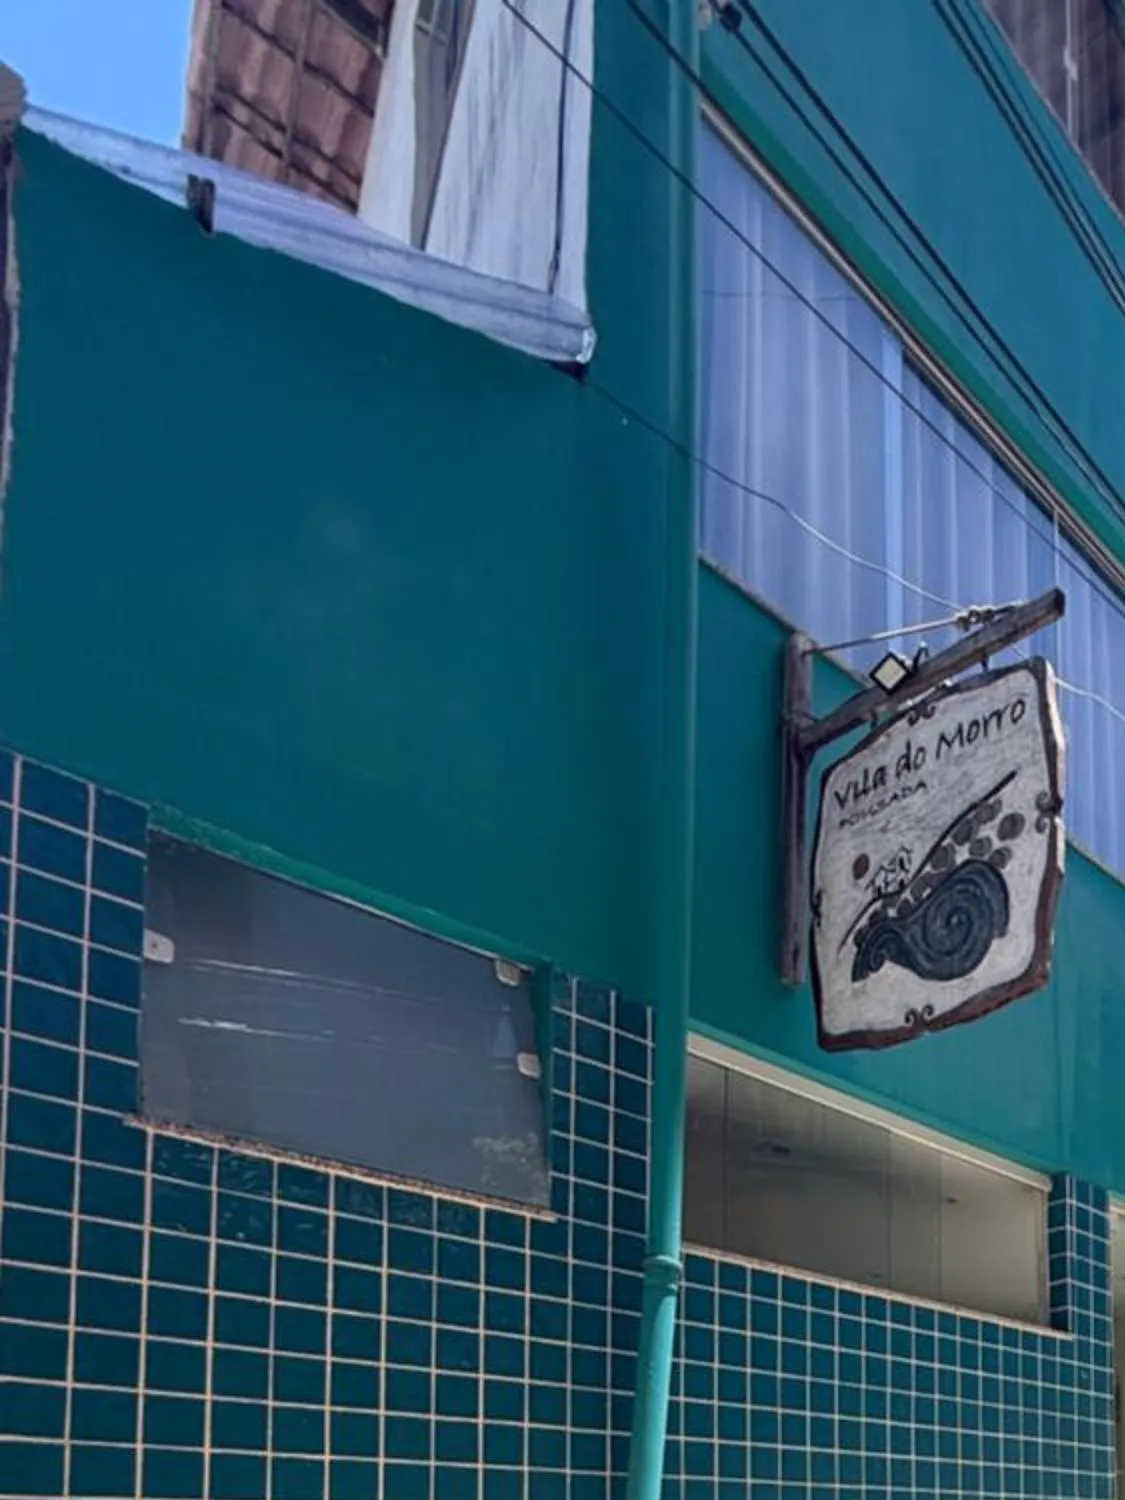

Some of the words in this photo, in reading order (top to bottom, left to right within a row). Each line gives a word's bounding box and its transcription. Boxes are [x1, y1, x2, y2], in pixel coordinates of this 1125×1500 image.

[834, 765, 887, 810] Vila
[895, 739, 926, 779] do
[935, 699, 1026, 760] Morro
